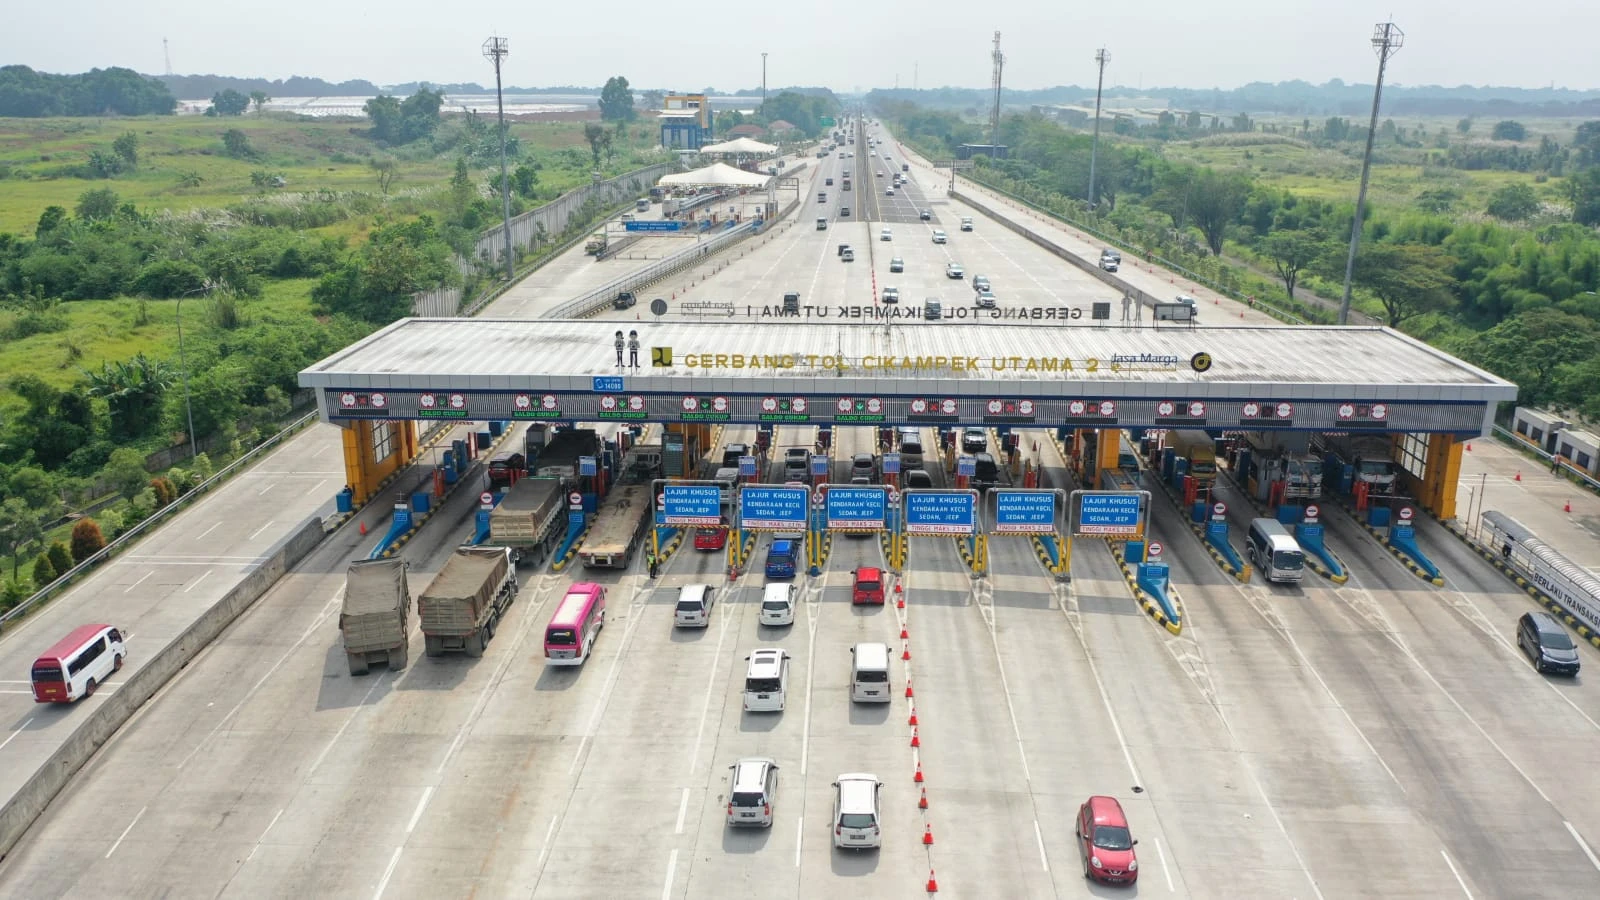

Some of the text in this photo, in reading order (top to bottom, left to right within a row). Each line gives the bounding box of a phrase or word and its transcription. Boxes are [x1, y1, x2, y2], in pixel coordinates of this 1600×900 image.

[685, 354, 1099, 372] GERBANG TOL CIKAMPEK UTAMA 2
[1112, 353, 1178, 366] Jasa Marga
[1534, 572, 1562, 600] BERLAKU
